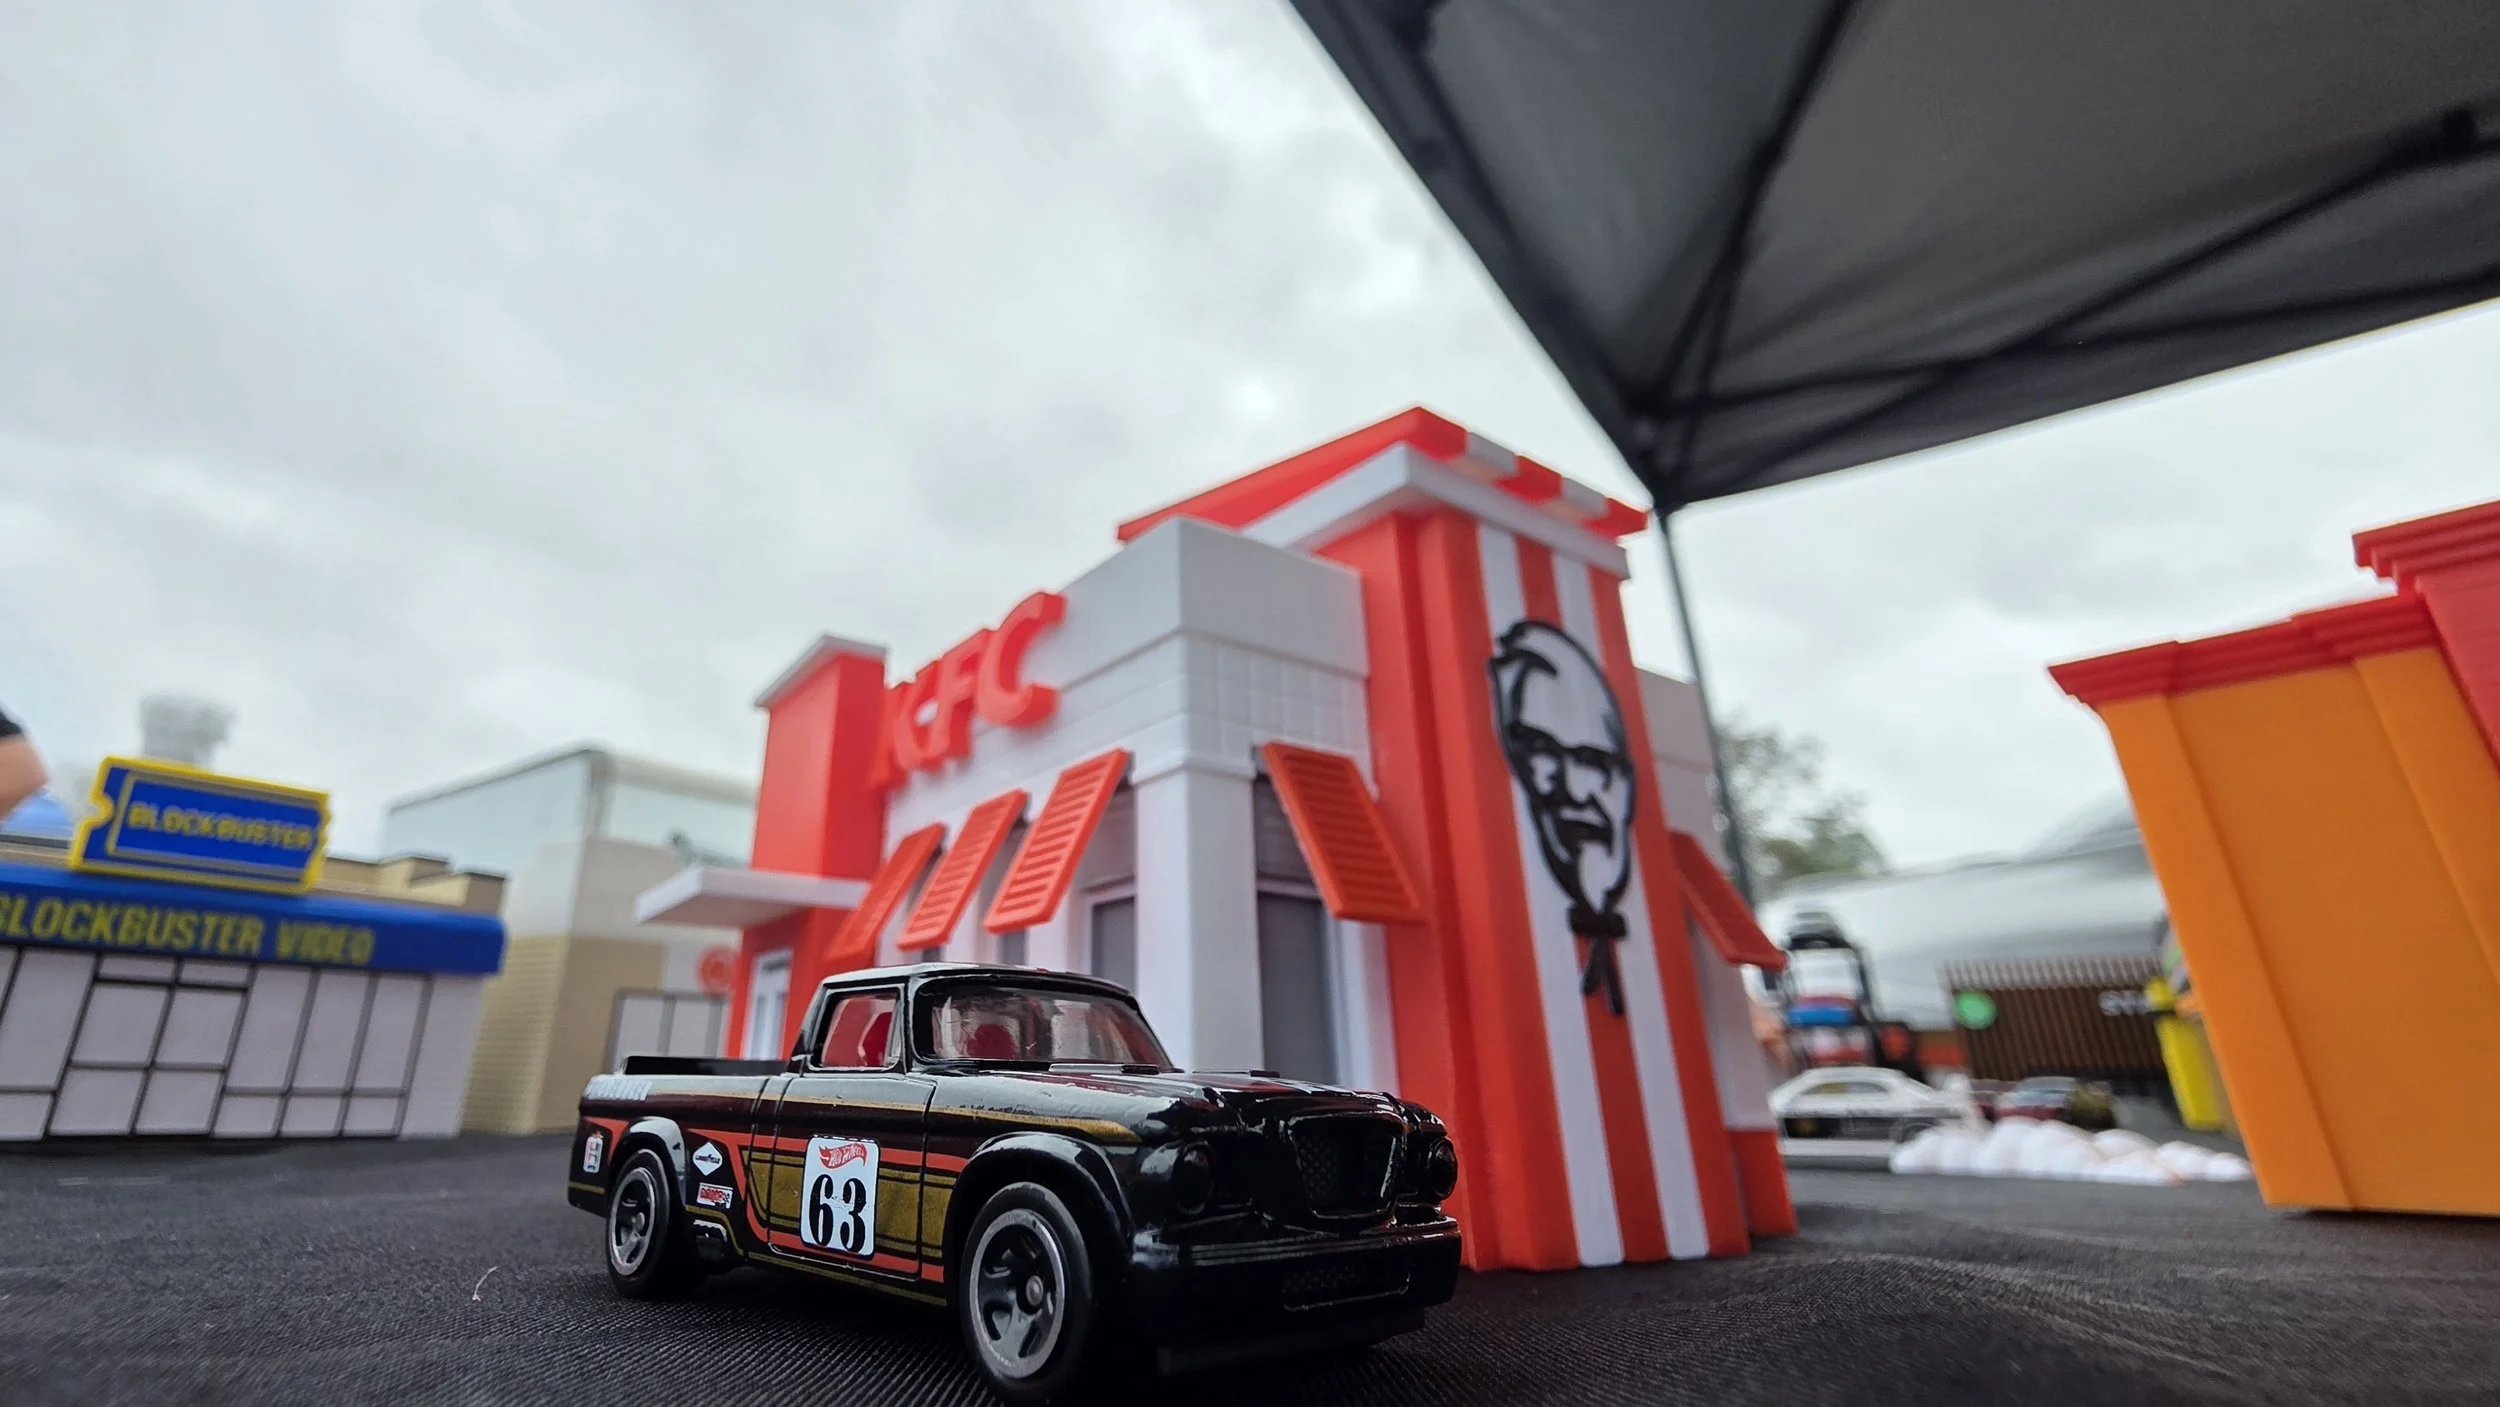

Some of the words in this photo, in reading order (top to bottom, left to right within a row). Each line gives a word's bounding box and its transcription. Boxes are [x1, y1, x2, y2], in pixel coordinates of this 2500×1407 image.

[869, 591, 1067, 783] KFC
[129, 803, 313, 849] BLOCKBUSTER
[275, 918, 375, 965] VIDEO
[809, 1174, 867, 1253] 63
